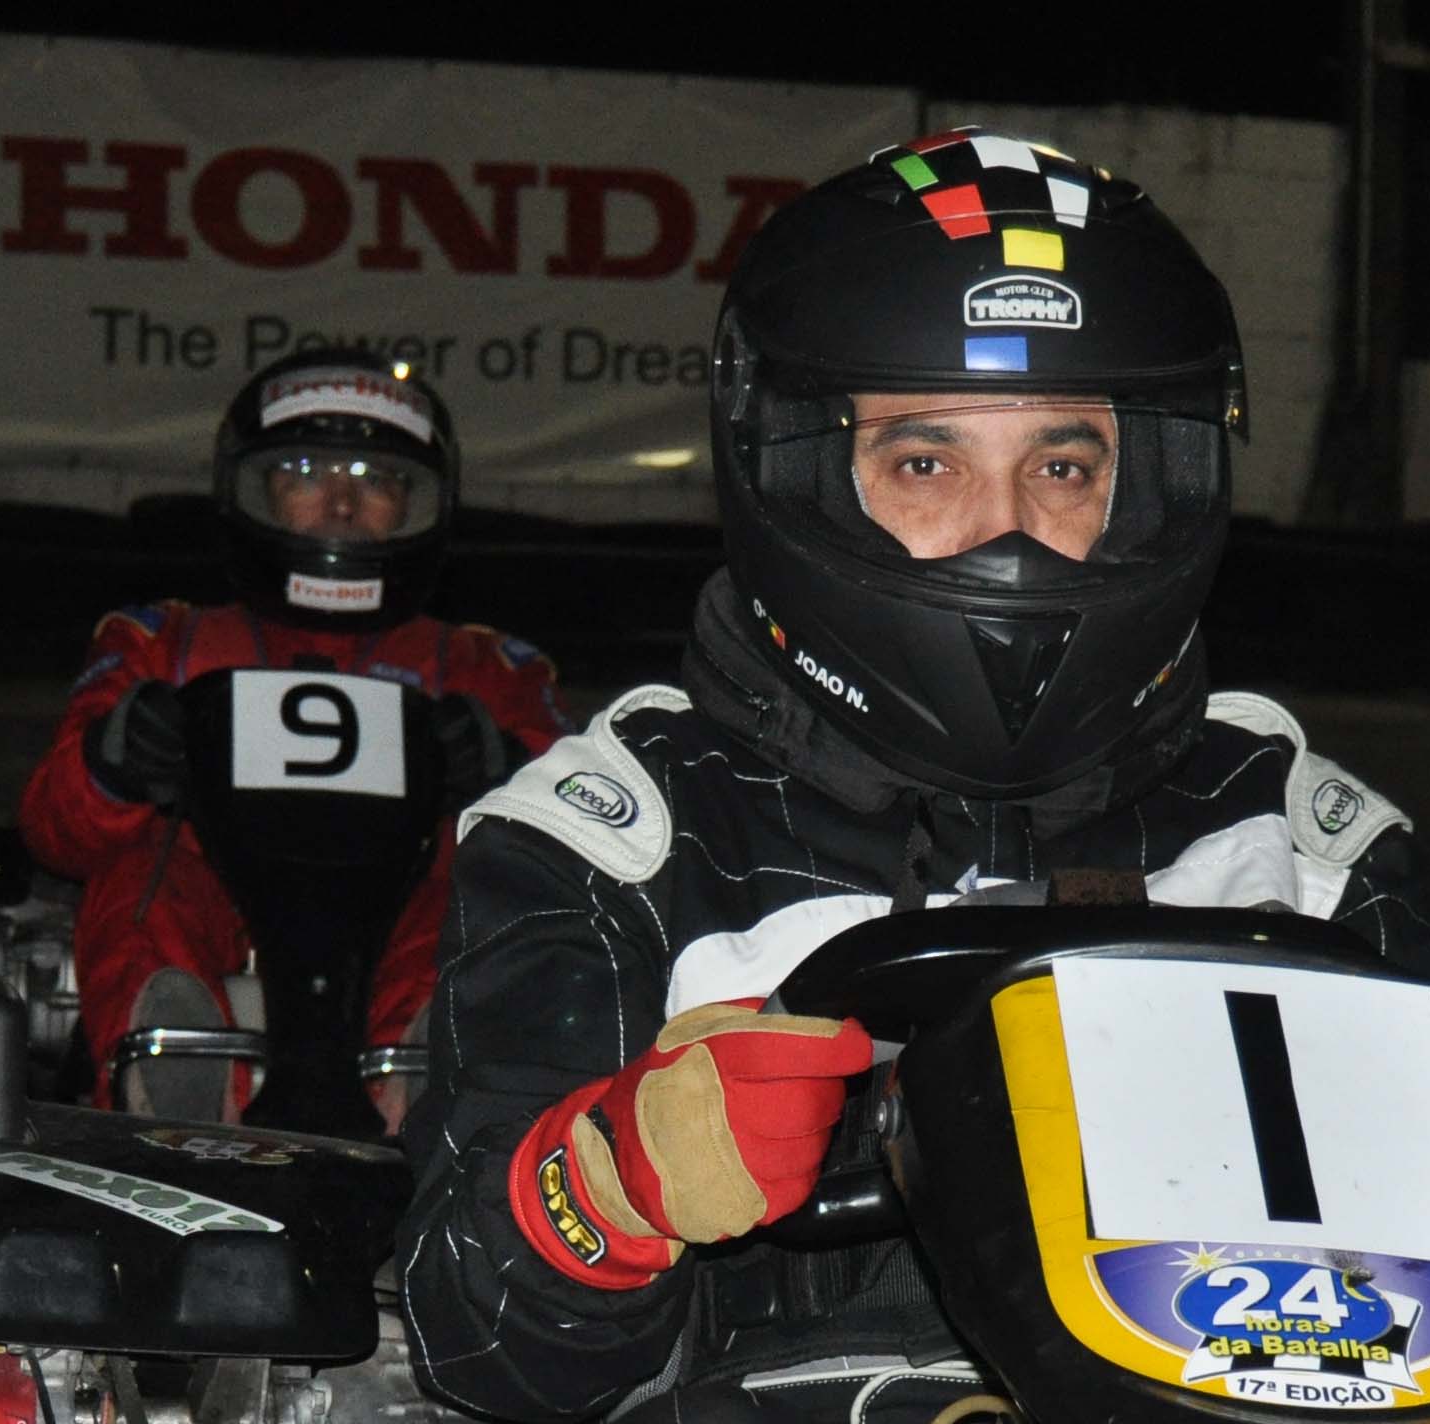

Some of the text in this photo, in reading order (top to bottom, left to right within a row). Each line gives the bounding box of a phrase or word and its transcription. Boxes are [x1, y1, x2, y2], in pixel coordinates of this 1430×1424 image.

[995, 284, 1029, 297] MOTOR
[971, 298, 1073, 321] TROPHY
[88, 306, 711, 385] The Per of Drea
[794, 650, 869, 712] JOAO N.
[279, 683, 360, 776] 9
[137, 1207, 196, 1234] EUROI
[541, 1162, 599, 1251] OMP
[1206, 1265, 1350, 1328] 24
[1243, 1313, 1331, 1335] horas
[1208, 1334, 1392, 1363] da Batalha
[1284, 1381, 1387, 1406] EDIÇÃO
